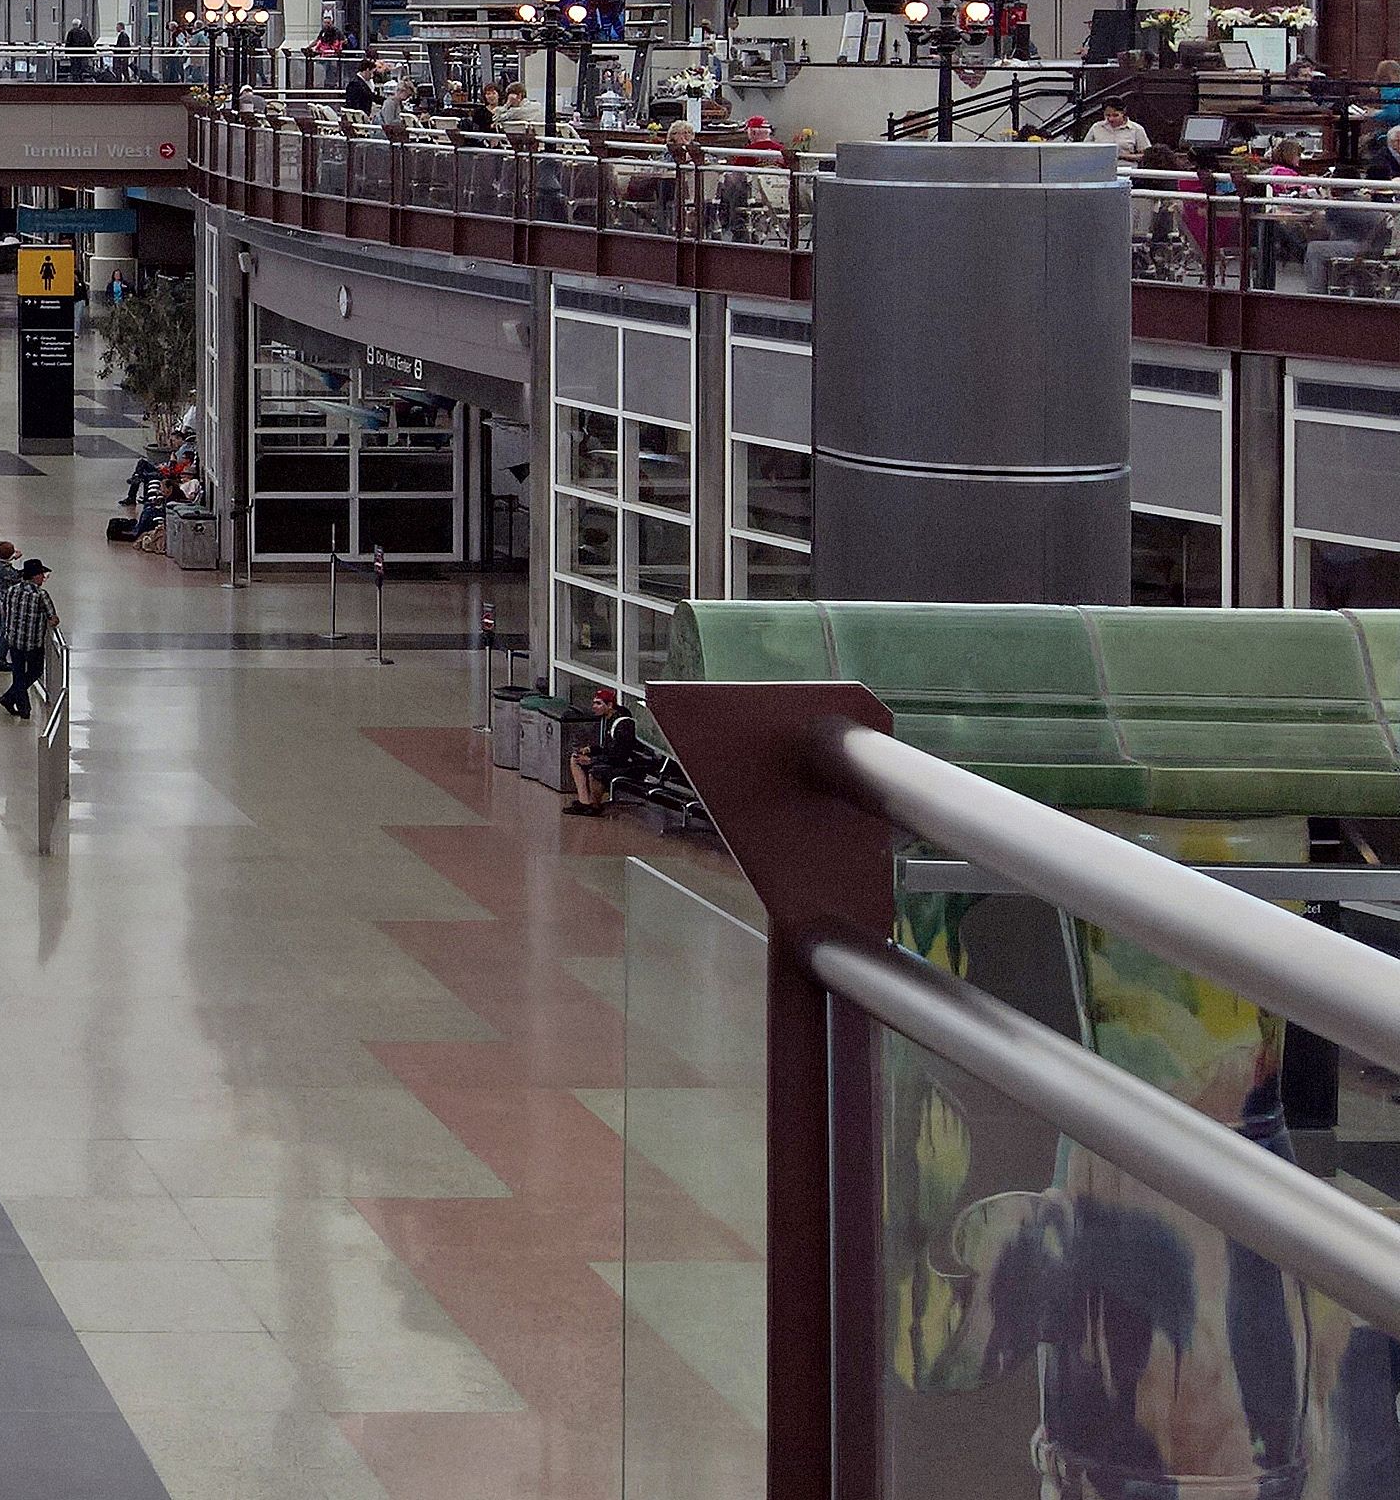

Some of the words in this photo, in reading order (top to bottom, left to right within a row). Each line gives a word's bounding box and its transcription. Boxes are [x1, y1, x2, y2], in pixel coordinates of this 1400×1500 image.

[23, 142, 99, 158] Terminal
[107, 143, 151, 158] West
[376, 350, 384, 366] Do
[386, 352, 397, 369] Not
[397, 356, 412, 374] Enter
